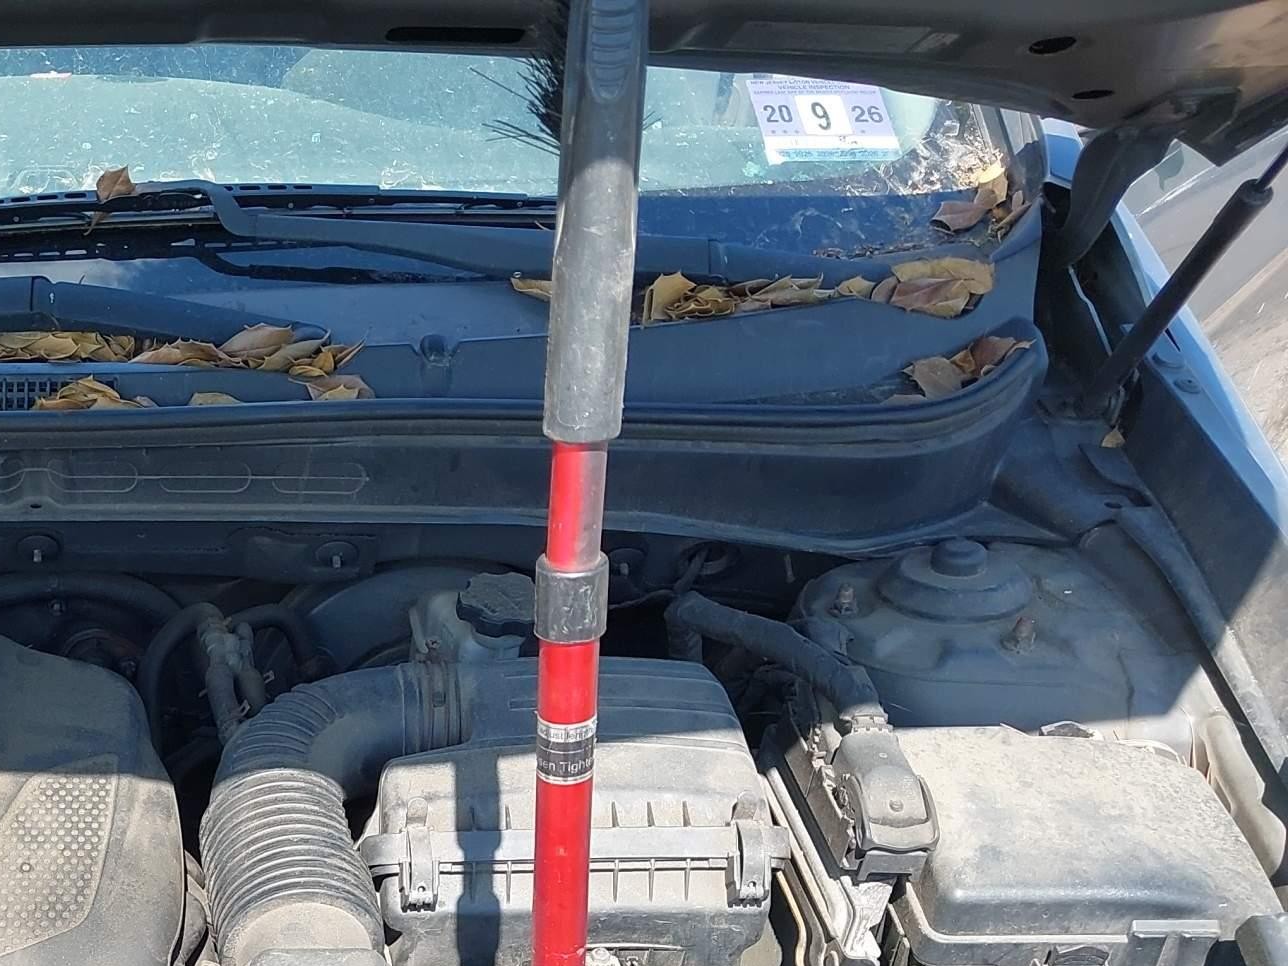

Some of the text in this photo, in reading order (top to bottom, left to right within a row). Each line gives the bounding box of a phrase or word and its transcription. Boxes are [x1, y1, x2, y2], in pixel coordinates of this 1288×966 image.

[763, 101, 884, 130] 20 9 26
